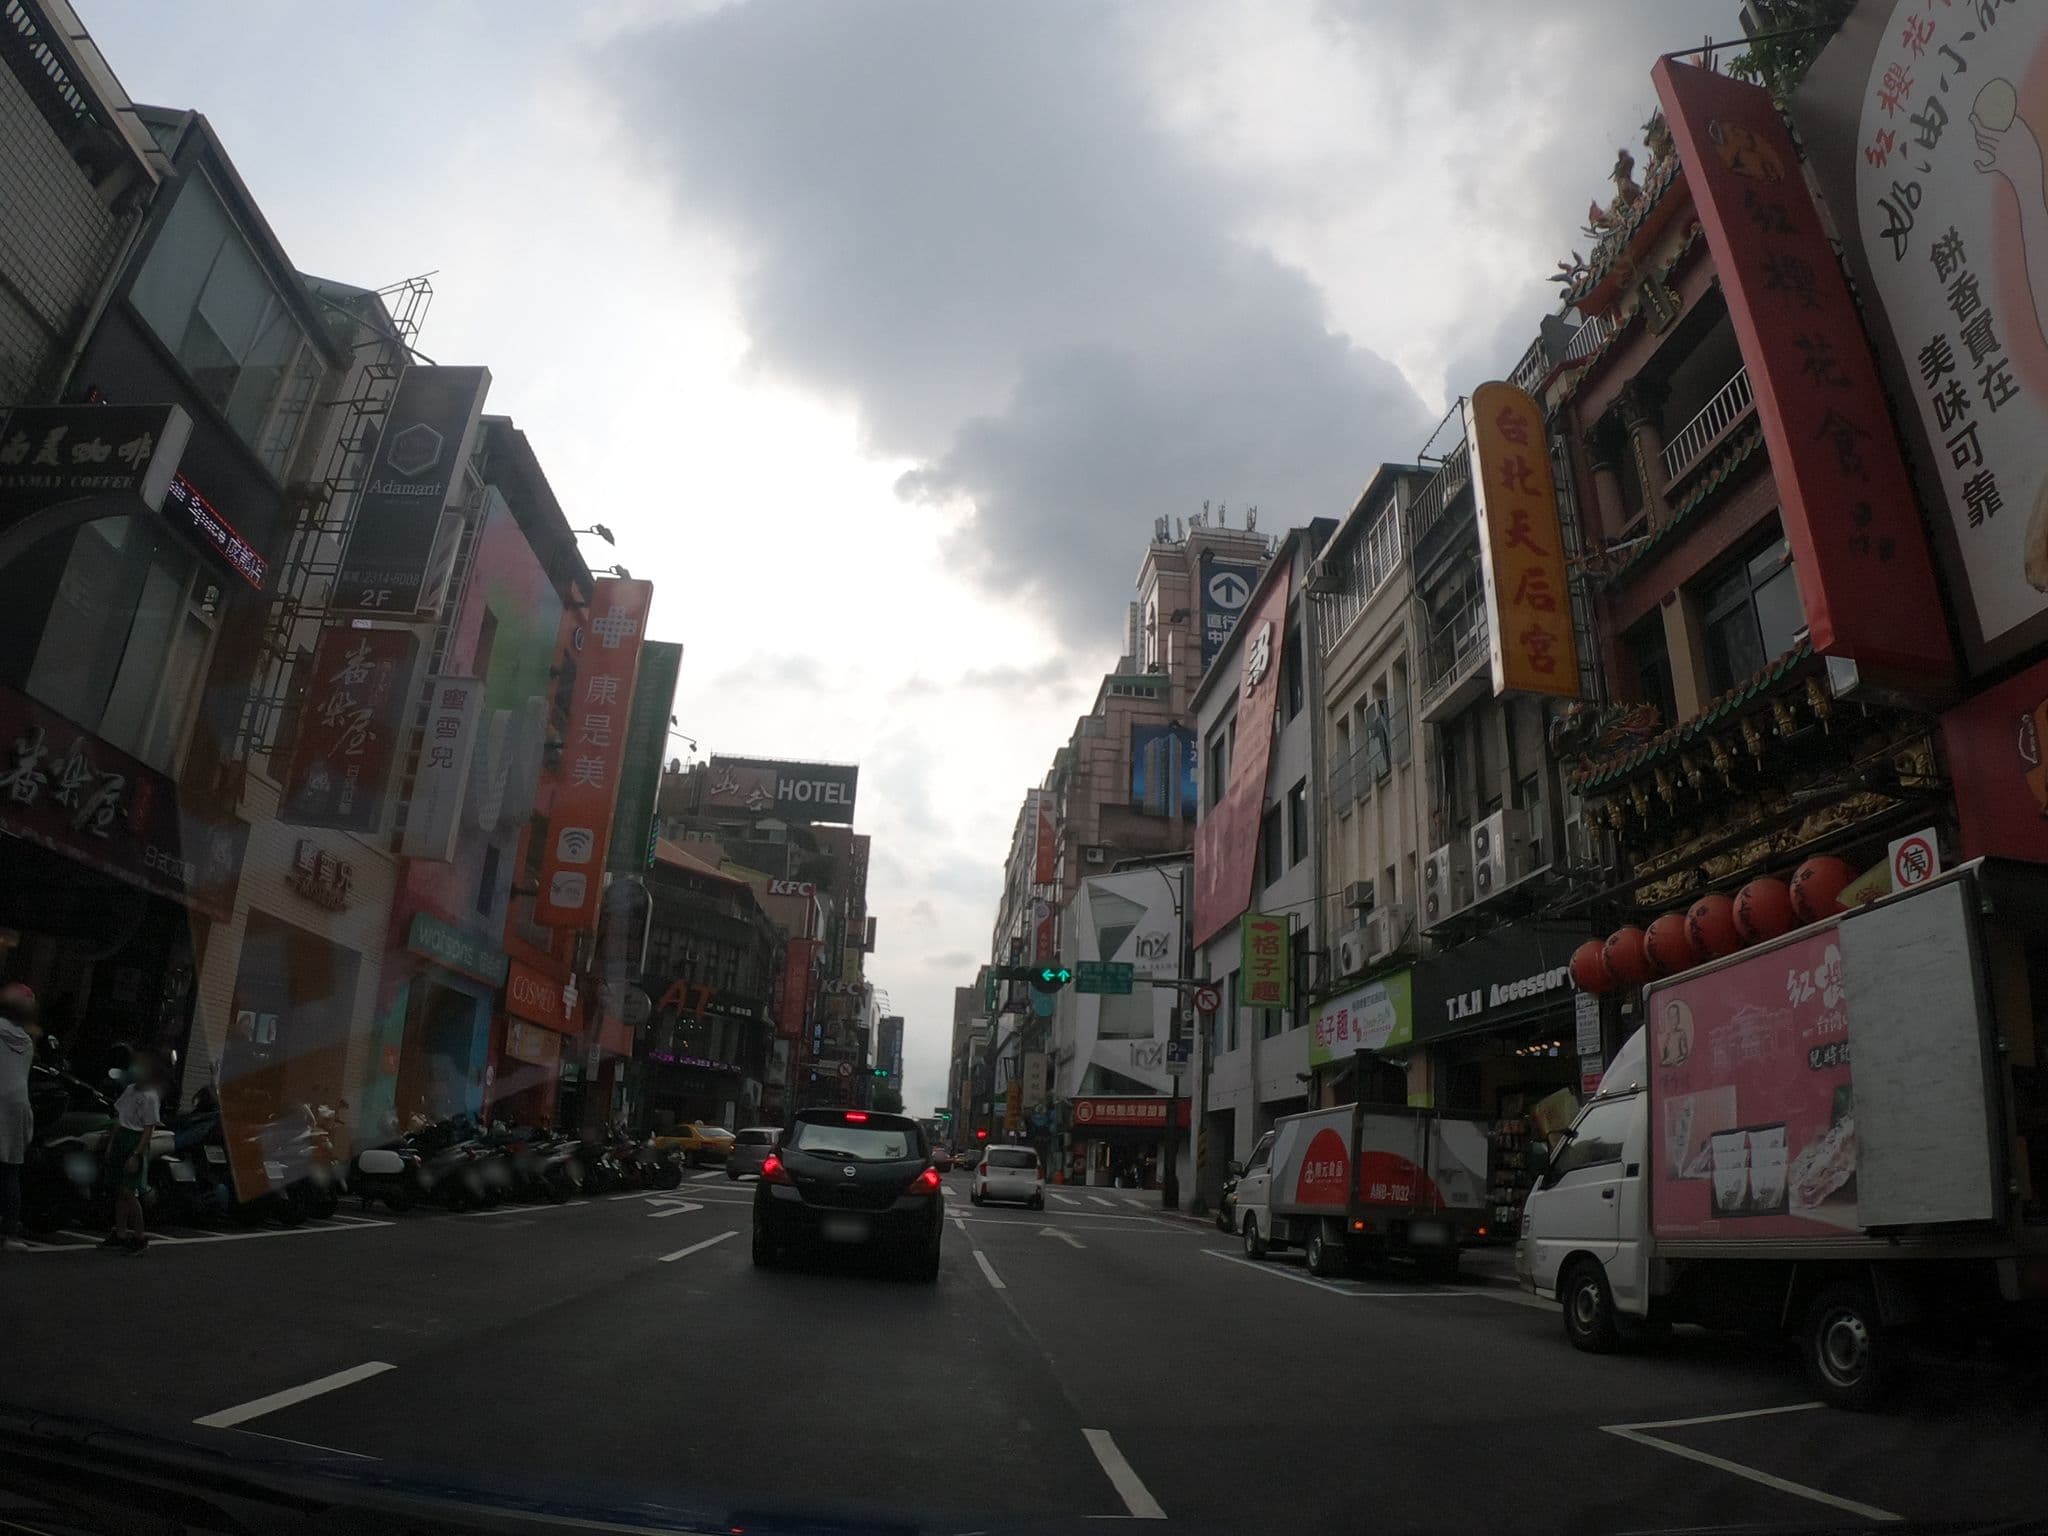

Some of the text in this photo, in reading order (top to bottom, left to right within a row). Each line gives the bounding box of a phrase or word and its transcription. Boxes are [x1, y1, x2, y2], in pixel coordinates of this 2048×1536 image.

[1866, 0, 1952, 169] 紅櫻花
[1929, 226, 2020, 413] 餅香實在
[1916, 334, 2004, 528] 美味可靠
[369, 480, 442, 495] Adamant
[1495, 405, 1558, 675] 台北天后宮
[360, 589, 392, 607] 2F
[427, 688, 467, 769] 蜜雪兒
[572, 674, 622, 789] 康是美
[777, 779, 852, 805] HOTEL
[769, 880, 813, 896] KFC
[1903, 848, 1932, 881] 停
[513, 975, 556, 1013] COSMED
